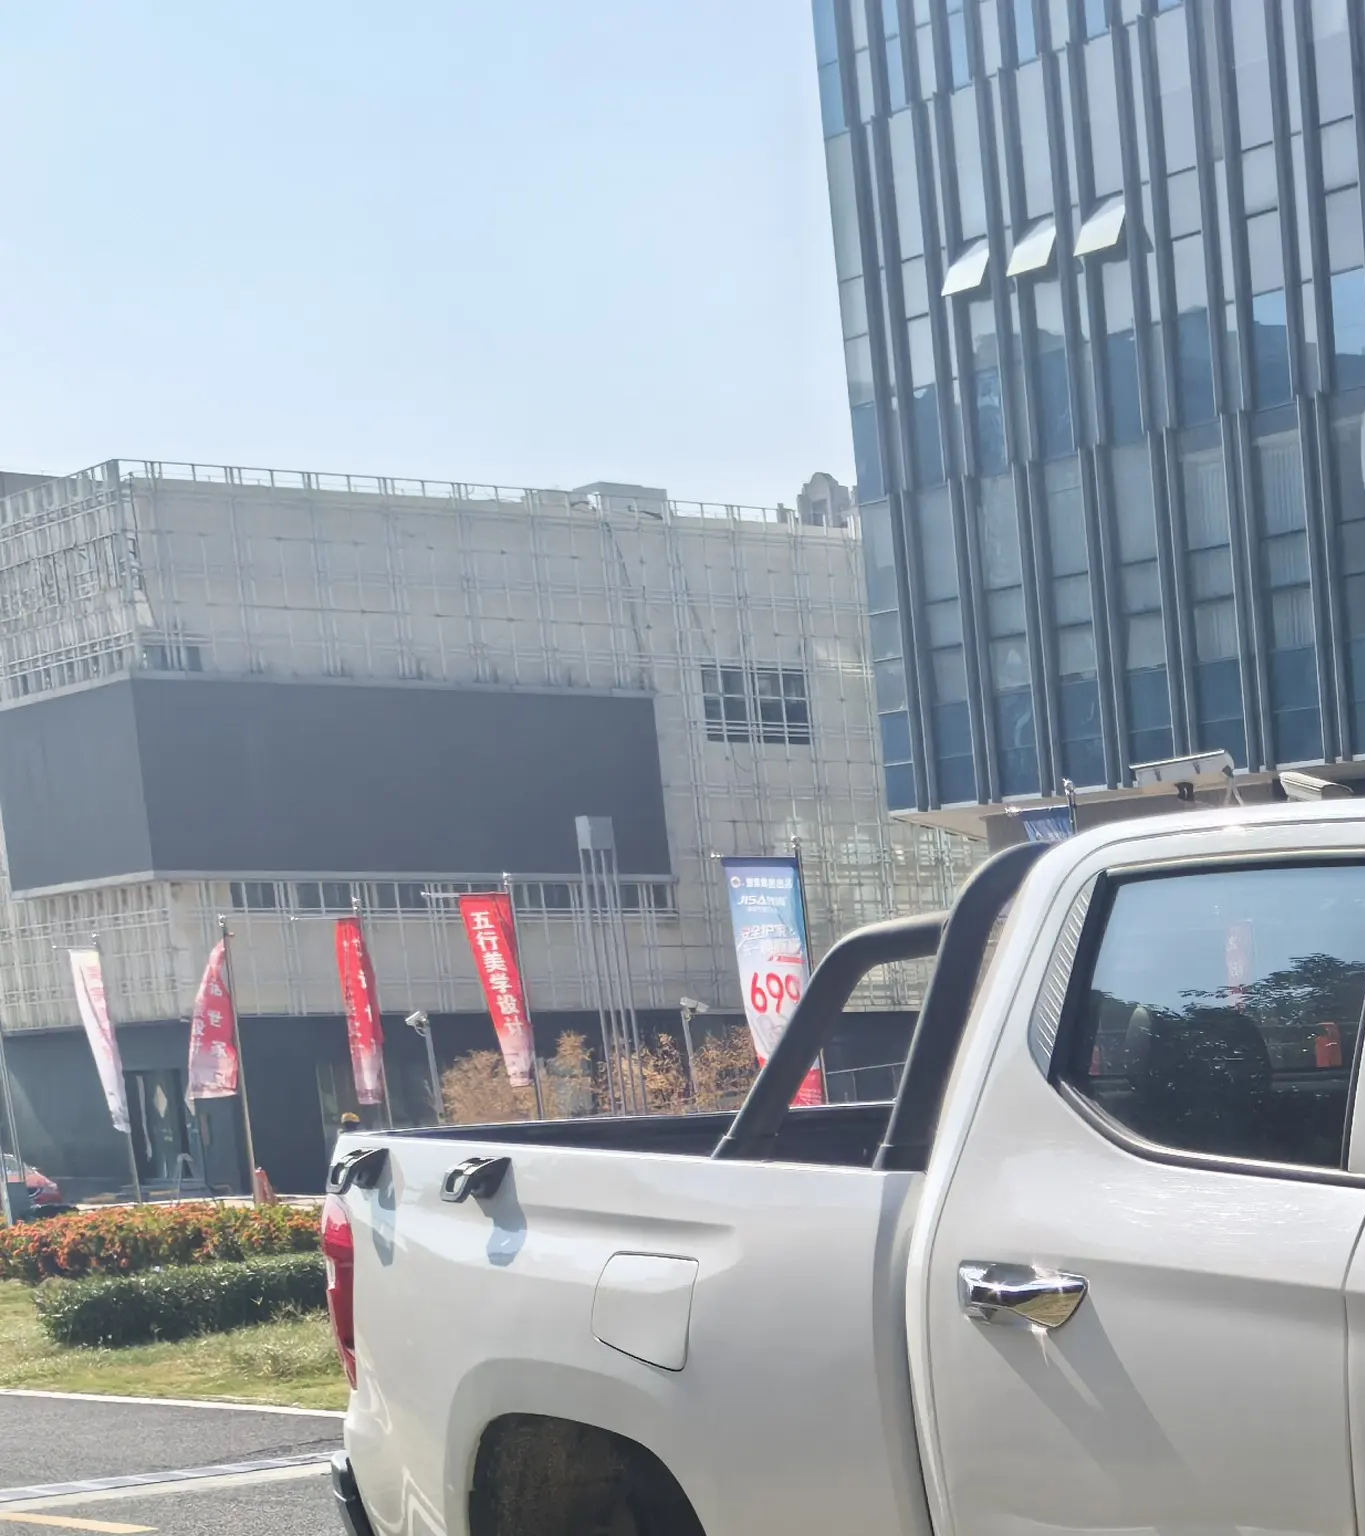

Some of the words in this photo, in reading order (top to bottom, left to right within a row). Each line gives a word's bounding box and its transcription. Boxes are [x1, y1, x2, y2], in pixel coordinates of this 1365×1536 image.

[470, 911, 525, 1036] 五行美学设计
